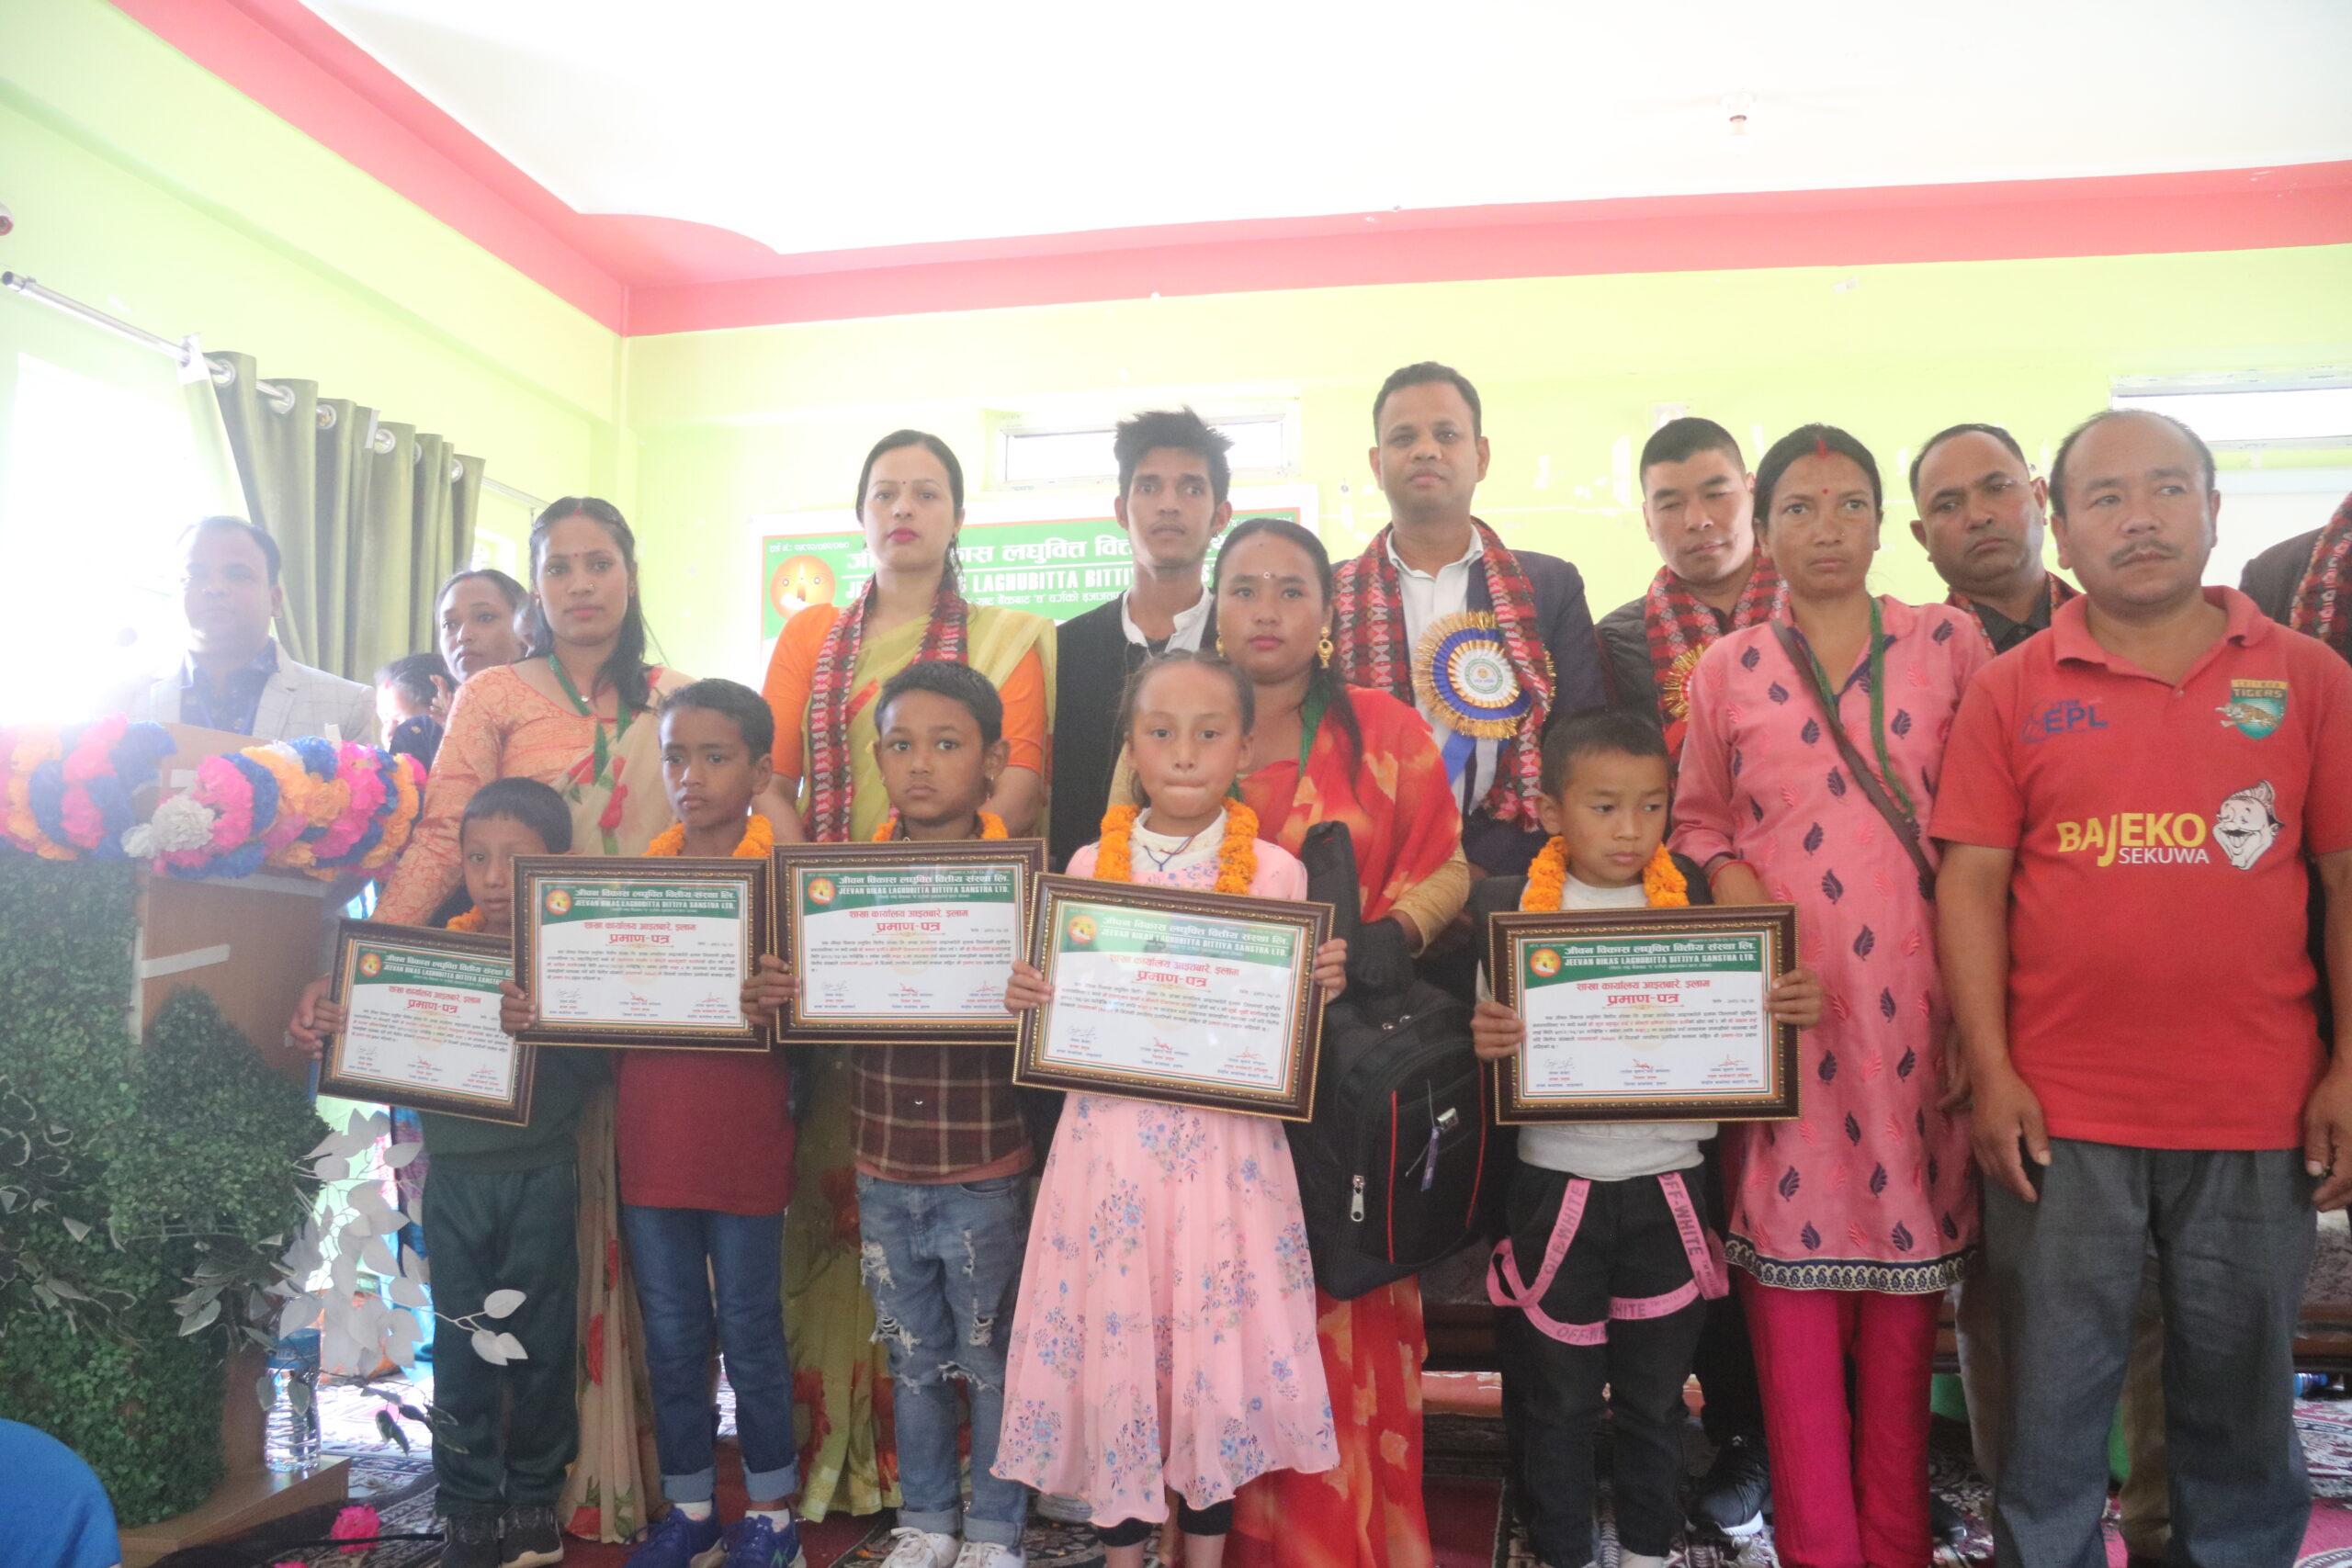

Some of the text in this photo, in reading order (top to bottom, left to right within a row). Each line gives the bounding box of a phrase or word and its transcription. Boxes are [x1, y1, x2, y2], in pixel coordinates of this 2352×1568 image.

[973, 570, 1079, 593] LAGHUBITTA
[1085, 568, 1134, 589] BITTI
[2232, 689, 2283, 698] TIGERS
[2042, 705, 2109, 733] EPL
[2056, 812, 2207, 867] BAJEKO
[2118, 847, 2210, 864] SEKUWA
